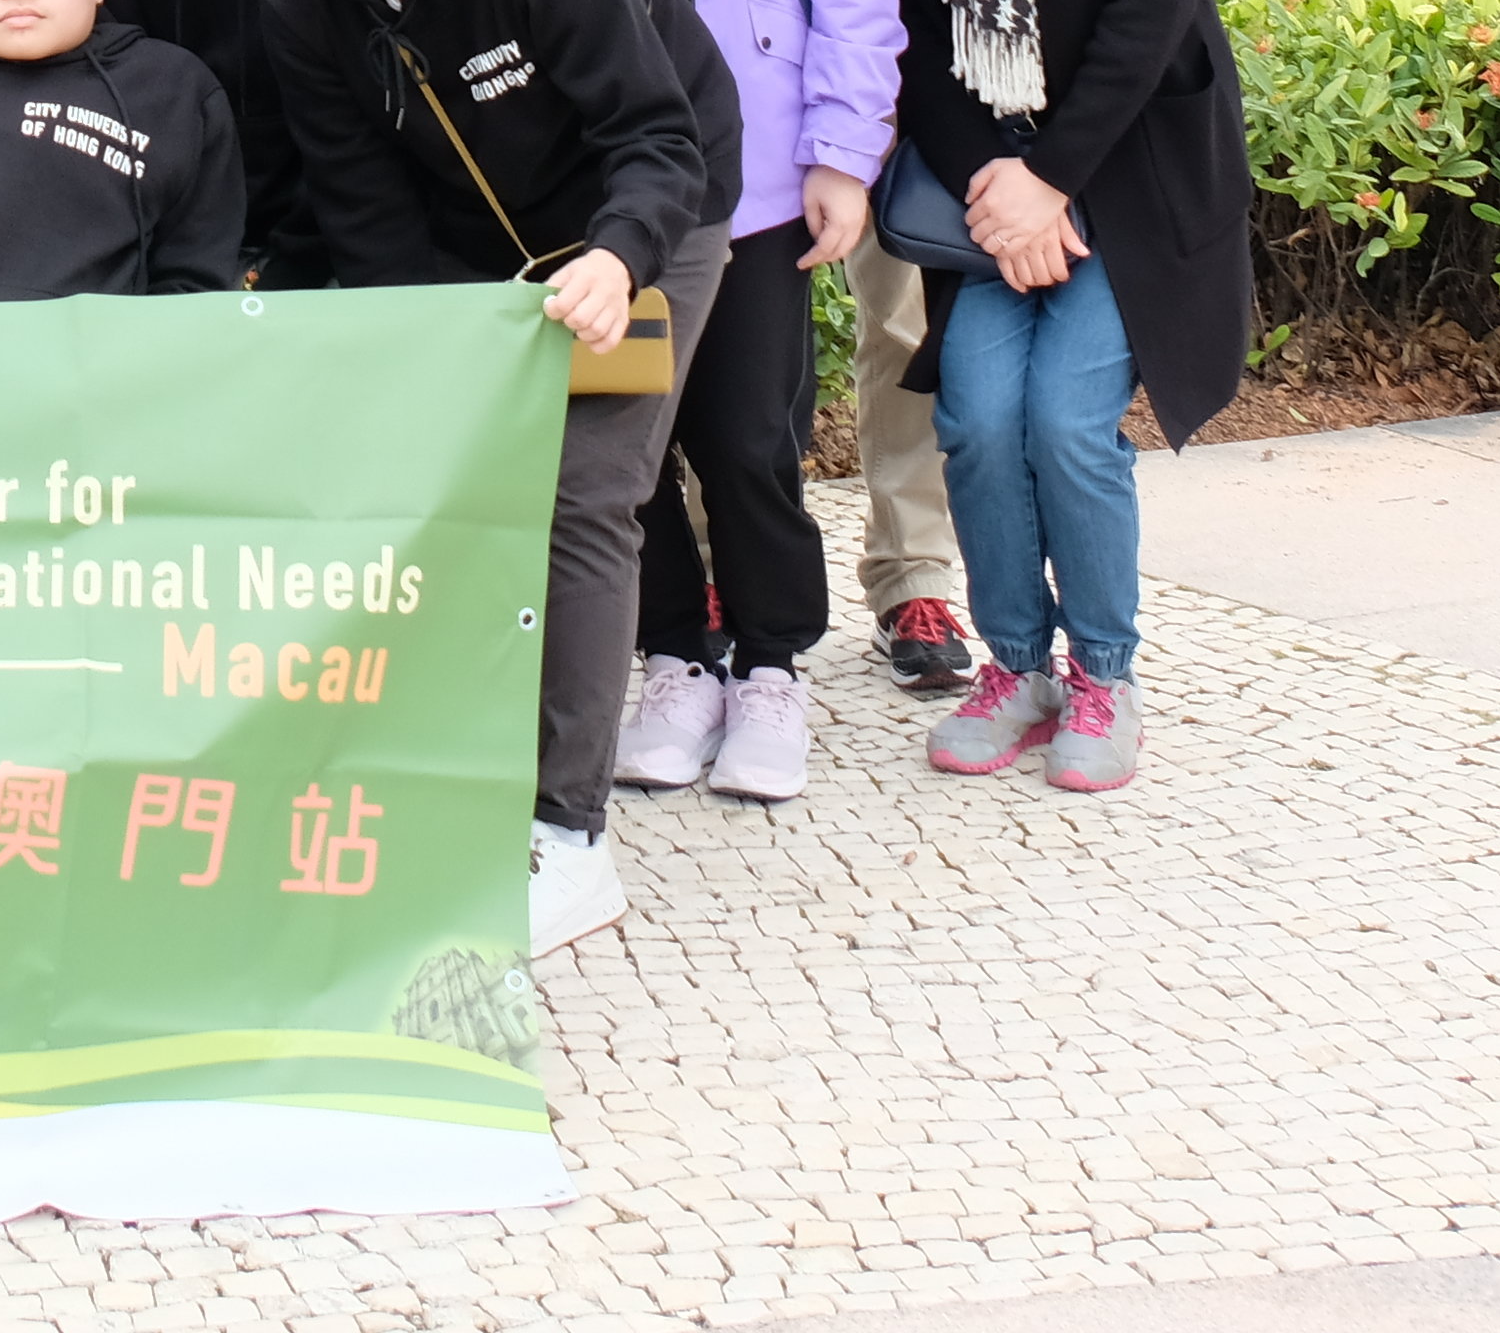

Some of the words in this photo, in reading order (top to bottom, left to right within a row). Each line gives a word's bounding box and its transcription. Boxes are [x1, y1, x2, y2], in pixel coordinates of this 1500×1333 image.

[21, 119, 46, 138] OF
[53, 124, 100, 157] HONG
[24, 101, 62, 119] CITY
[45, 459, 136, 525] for
[238, 544, 424, 615] Needs
[162, 621, 389, 704] Macau
